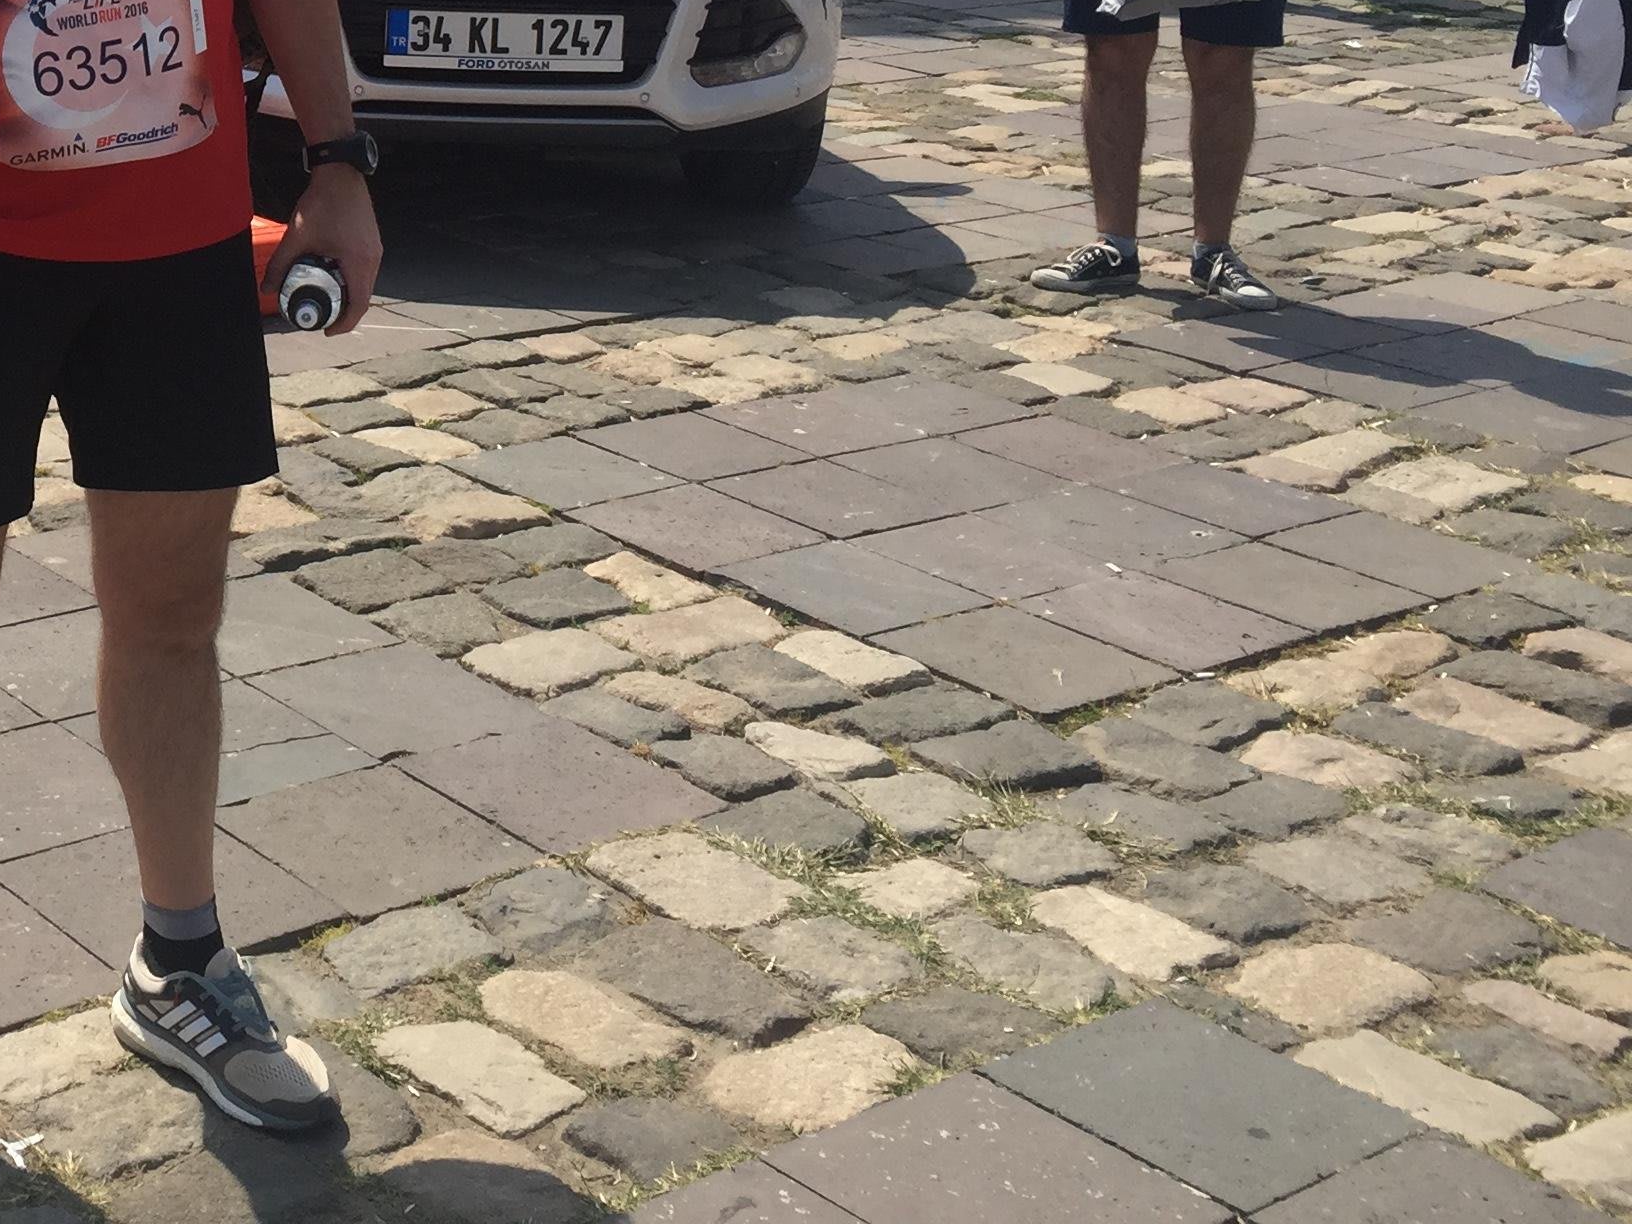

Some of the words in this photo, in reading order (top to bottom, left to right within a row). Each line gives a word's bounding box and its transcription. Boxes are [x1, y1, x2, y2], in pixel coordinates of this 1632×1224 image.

[124, 0, 149, 19] 2016
[391, 36, 407, 47] TR
[410, 15, 452, 53] 34
[468, 16, 509, 54] KL
[531, 19, 613, 57] 1247
[33, 25, 183, 97] 63512
[458, 58, 495, 69] FORD
[497, 59, 550, 71] OTOSAN
[96, 122, 179, 149] BFGoodrich
[10, 141, 88, 166] GARMIN
